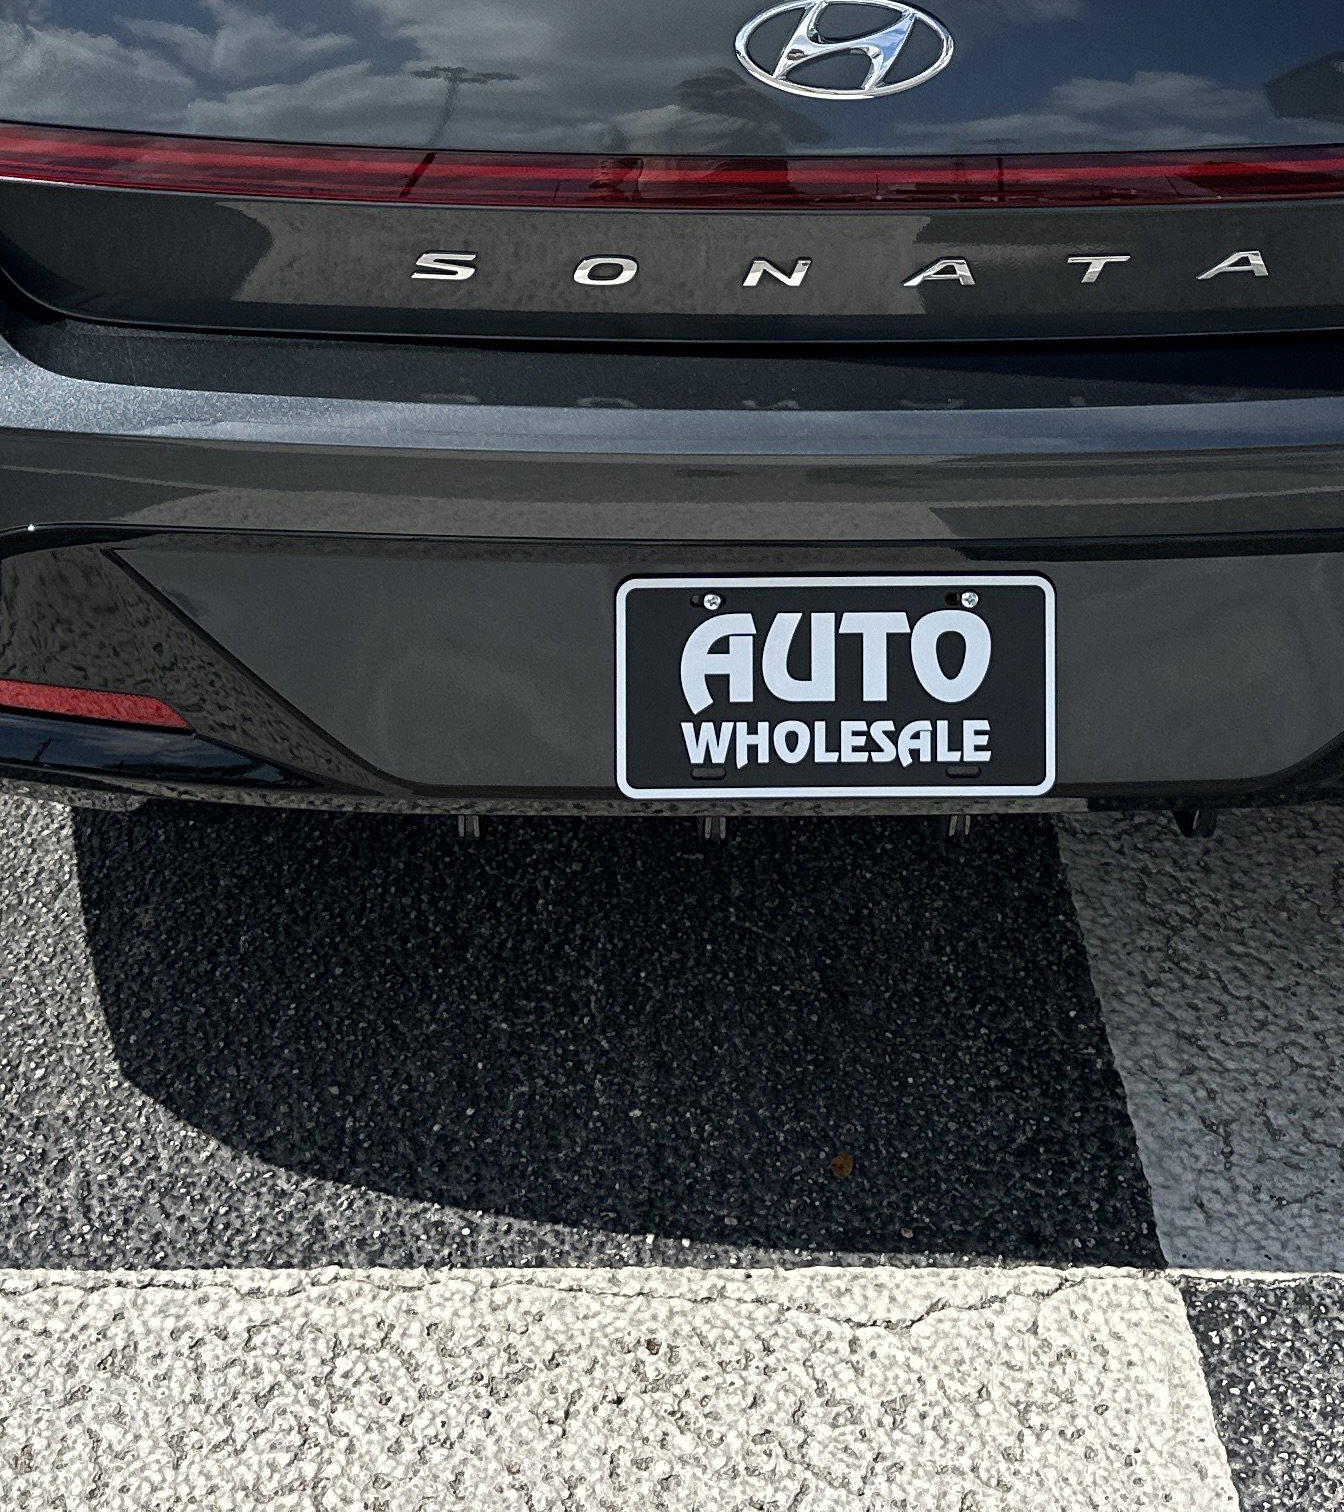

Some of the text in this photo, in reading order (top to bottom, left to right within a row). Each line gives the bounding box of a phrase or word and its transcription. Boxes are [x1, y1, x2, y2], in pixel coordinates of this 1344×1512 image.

[411, 250, 1271, 288] SONATA
[680, 609, 992, 715] AUTO
[680, 719, 992, 769] WHOLESALE
